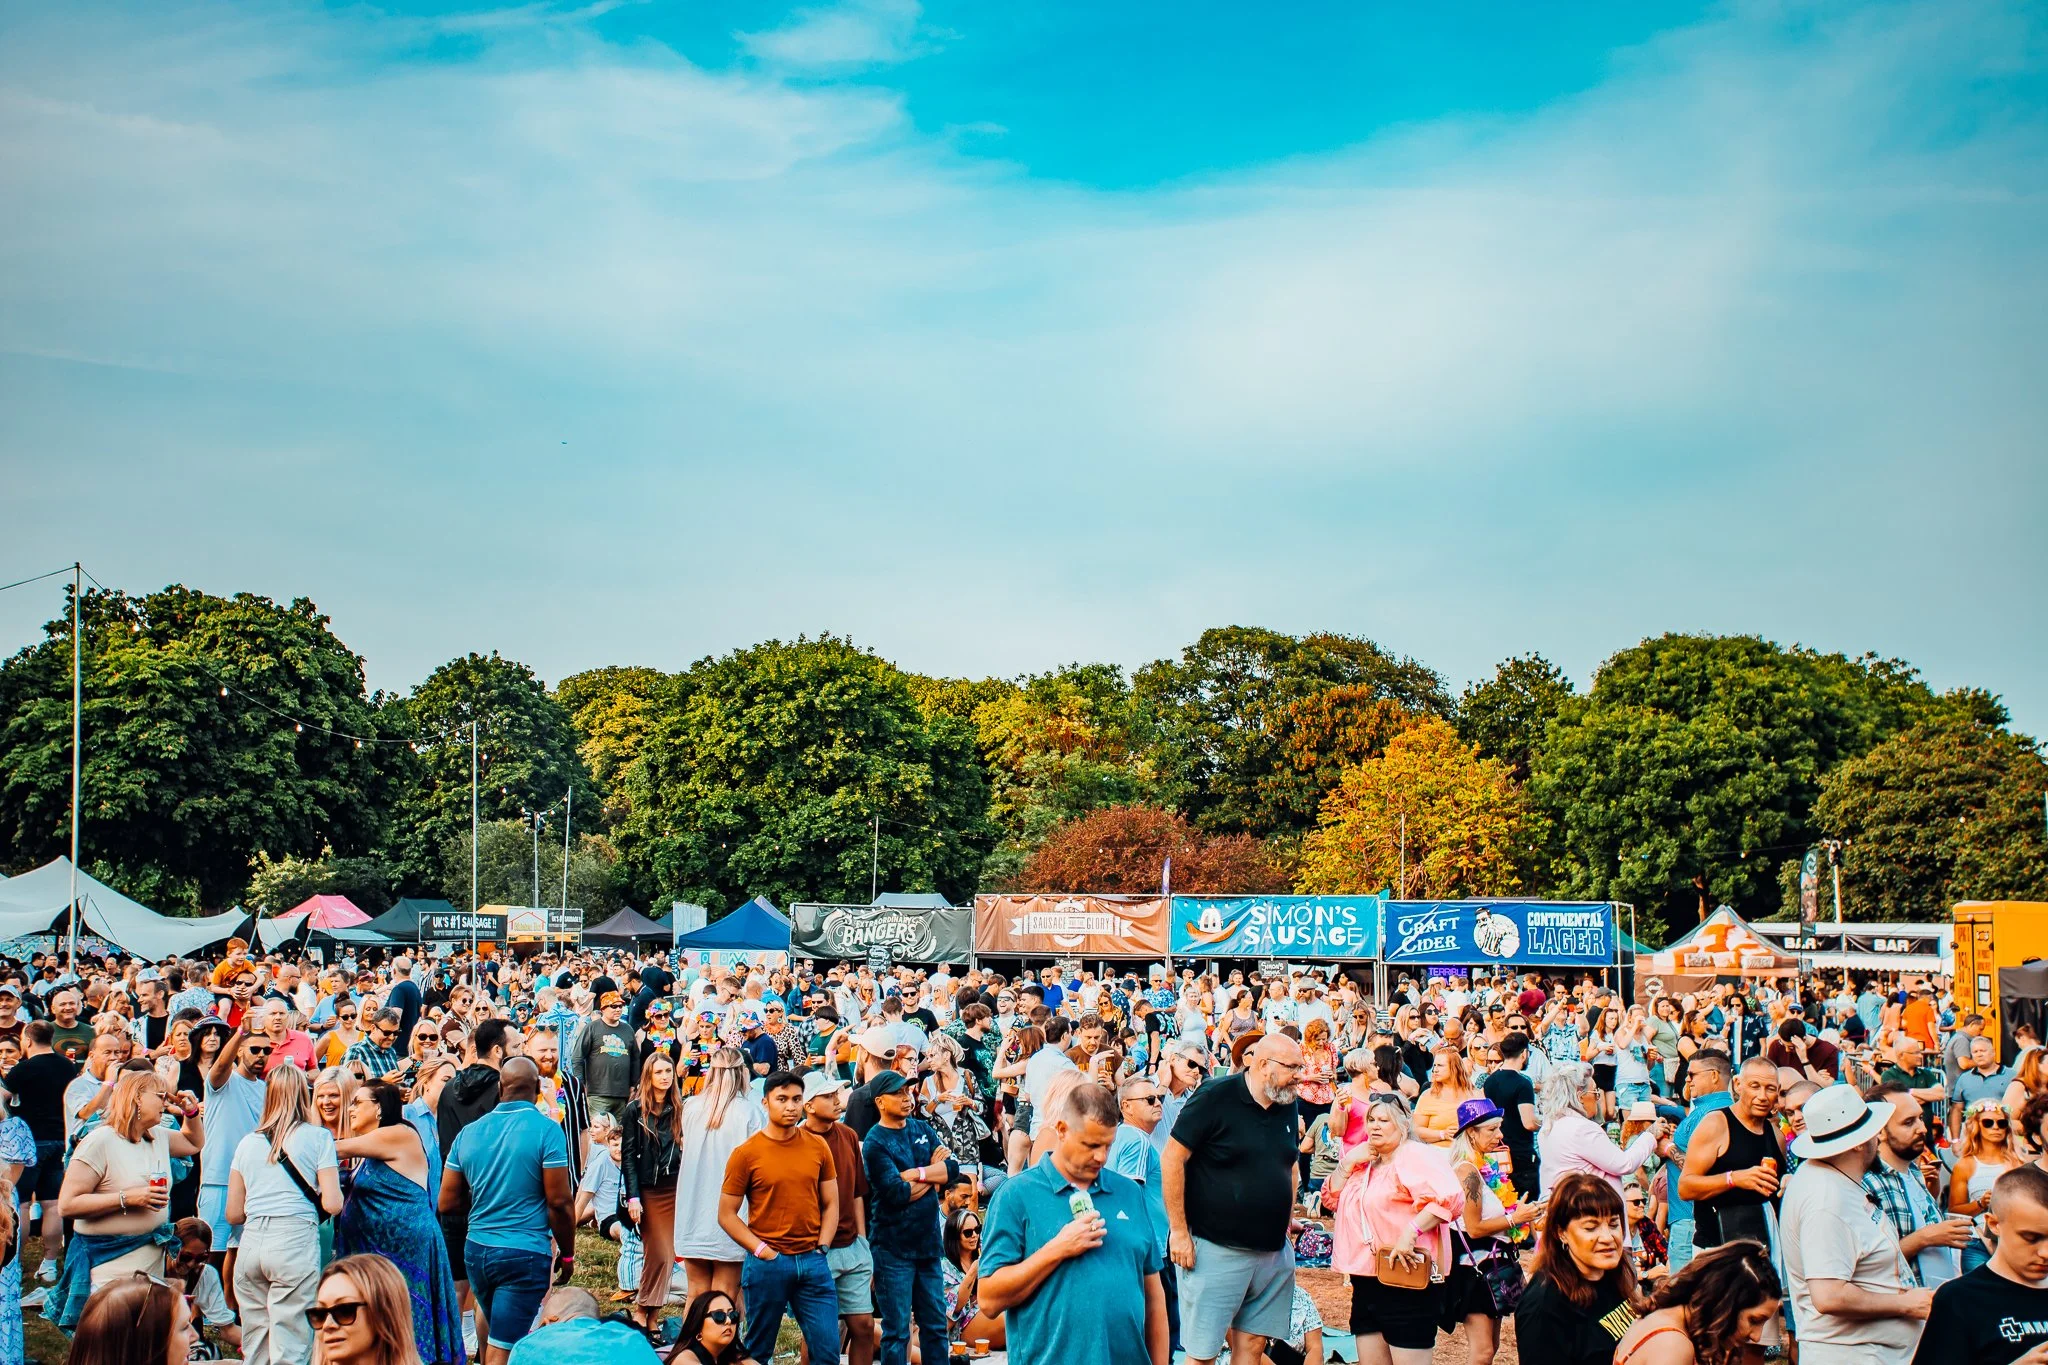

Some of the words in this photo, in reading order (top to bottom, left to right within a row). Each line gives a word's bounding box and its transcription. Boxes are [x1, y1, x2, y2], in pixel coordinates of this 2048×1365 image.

[433, 916, 449, 928] UK'S
[450, 914, 461, 930] #1
[855, 916, 914, 928] EXTRAORDINARY
[1033, 916, 1066, 929] SAUSAGE
[1086, 917, 1110, 930] GLORY
[1250, 906, 1357, 926] SIMON'S
[1527, 911, 1604, 928] CONTINENTAL
[841, 922, 917, 946] BANGERS
[1397, 916, 1460, 936] CRAFT
[1244, 927, 1363, 946] SAUSAGE
[1400, 935, 1457, 953] CIDER
[1527, 928, 1606, 956] LAGER
[1874, 938, 1911, 952] BAR
[1428, 967, 1468, 977] TERRIBLE
